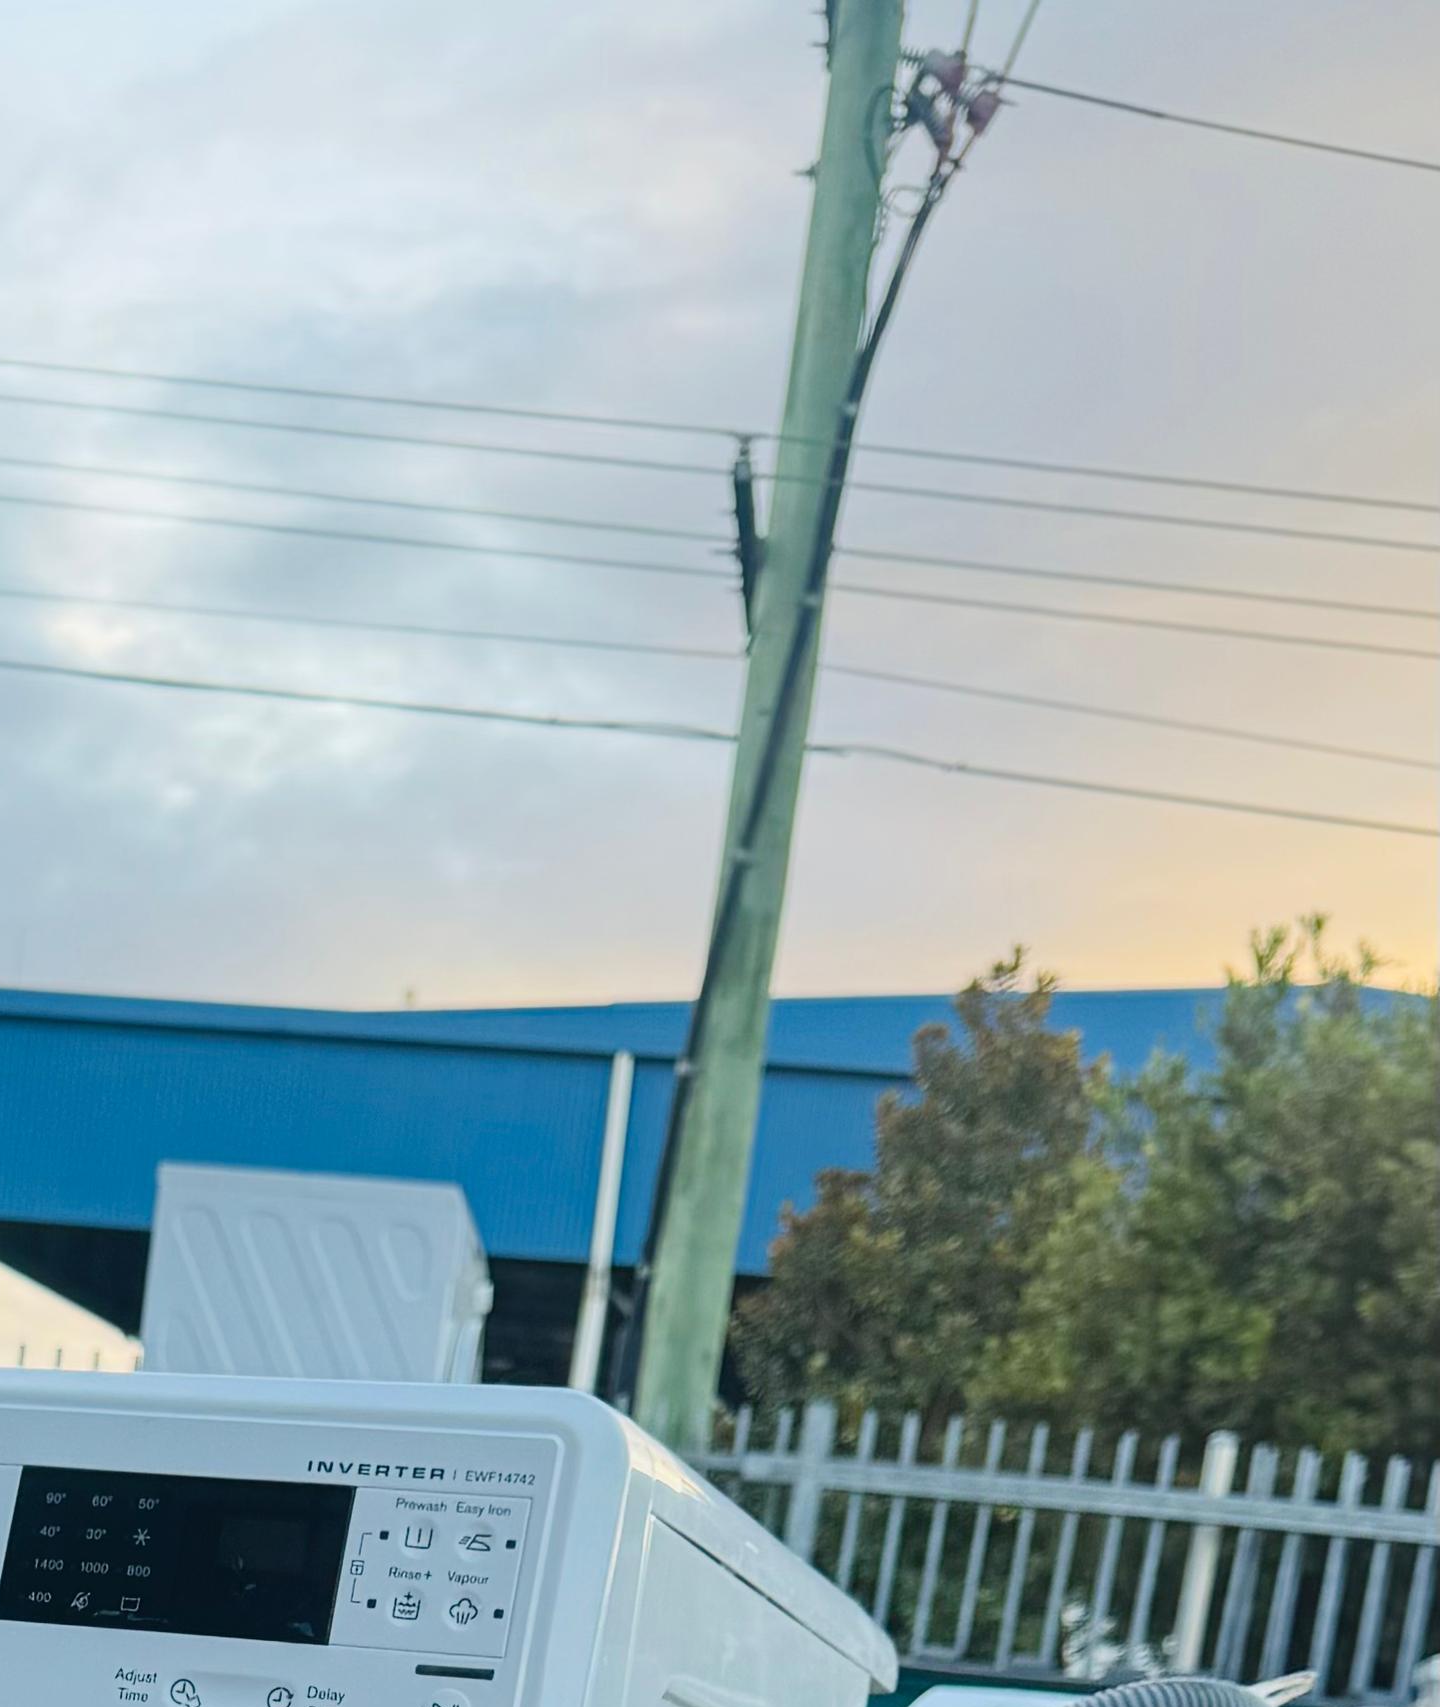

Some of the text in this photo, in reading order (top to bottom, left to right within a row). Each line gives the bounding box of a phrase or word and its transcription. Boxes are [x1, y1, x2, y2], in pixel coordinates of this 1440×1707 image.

[307, 1460, 536, 1486] INVERTER EWF14742
[395, 1497, 448, 1513] Prewash
[456, 1501, 512, 1518] Easy Iron
[34, 1558, 64, 1571] 1400
[81, 1561, 109, 1575] 1000
[448, 1570, 489, 1585] Vapour
[115, 1668, 158, 1685] Adjust
[118, 1687, 149, 1702] Time
[307, 1685, 346, 1704] Delay
